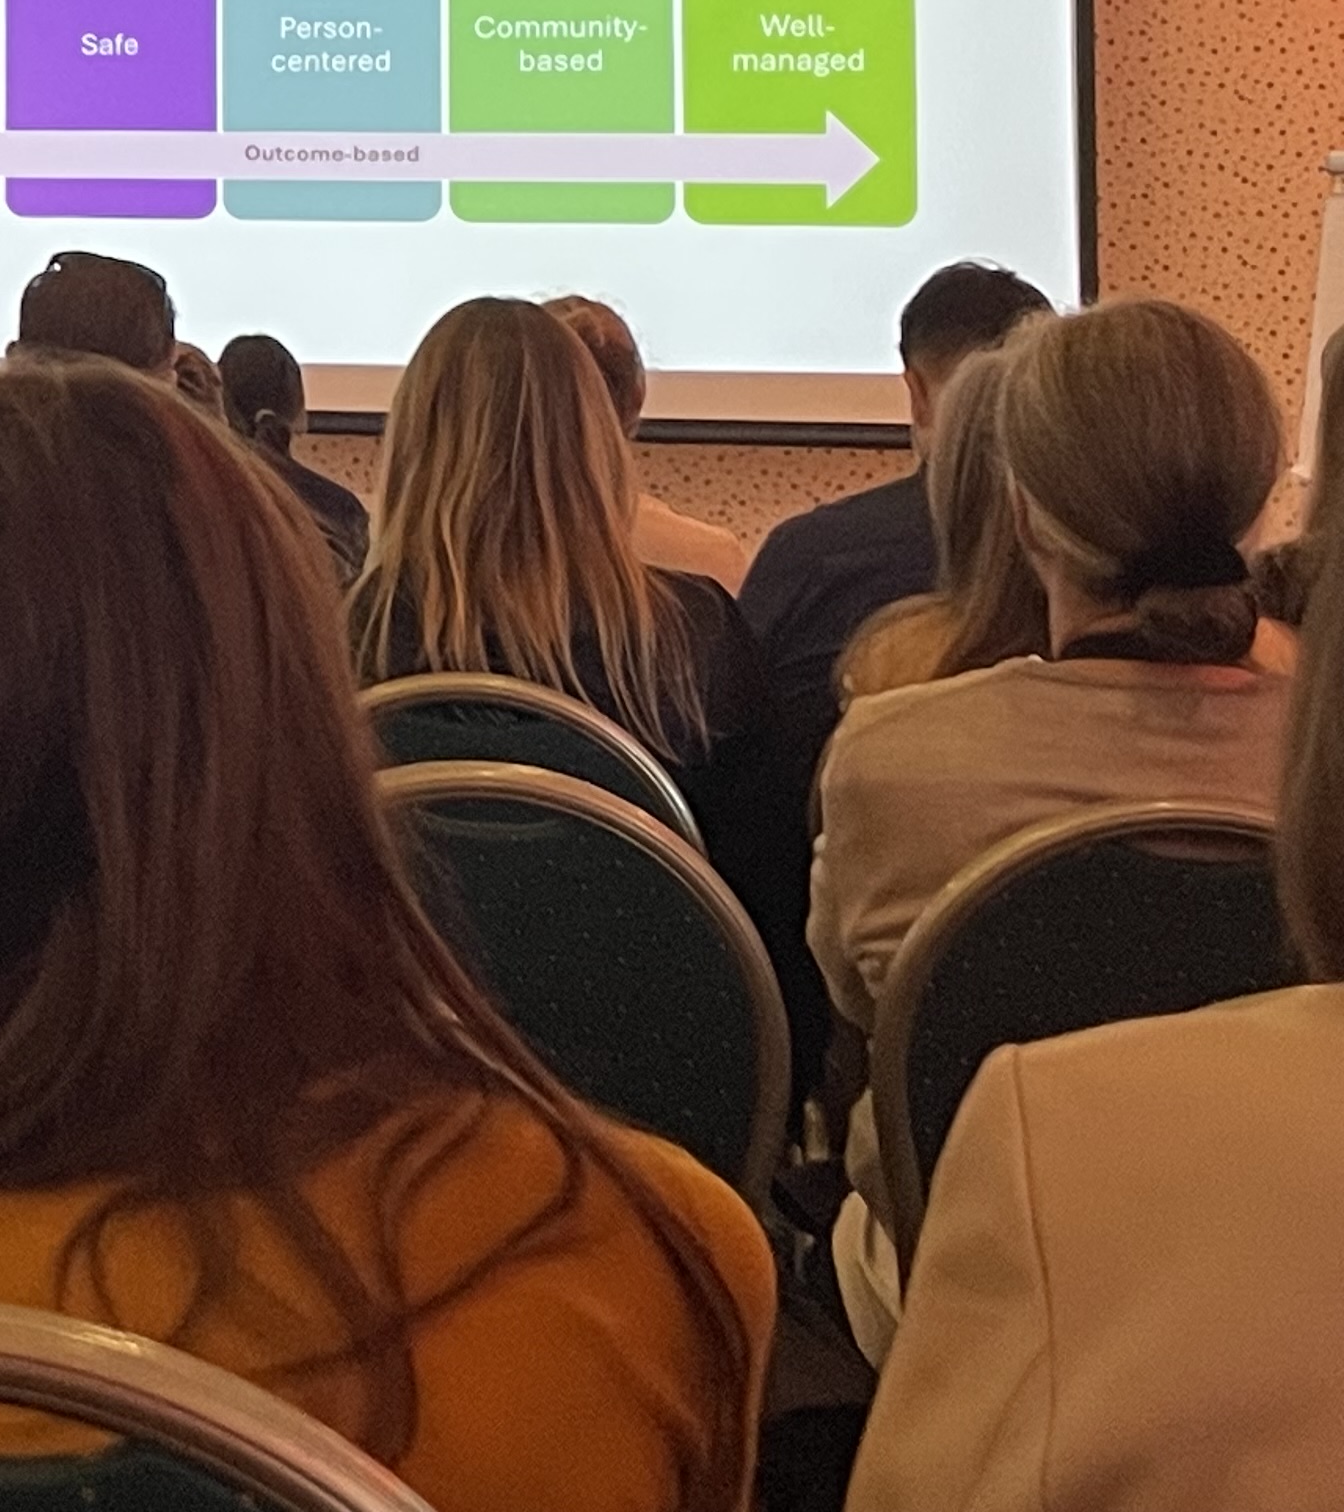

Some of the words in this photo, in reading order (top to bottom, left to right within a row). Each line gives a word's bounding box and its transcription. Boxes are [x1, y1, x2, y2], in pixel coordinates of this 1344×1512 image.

[280, 16, 383, 40] Person-
[474, 15, 648, 44] Community-
[759, 12, 835, 38] Well-
[80, 32, 139, 57] Safe
[271, 48, 391, 73] centered
[519, 48, 603, 72] based
[733, 47, 865, 78] managed
[244, 143, 420, 164] Outcome-based
